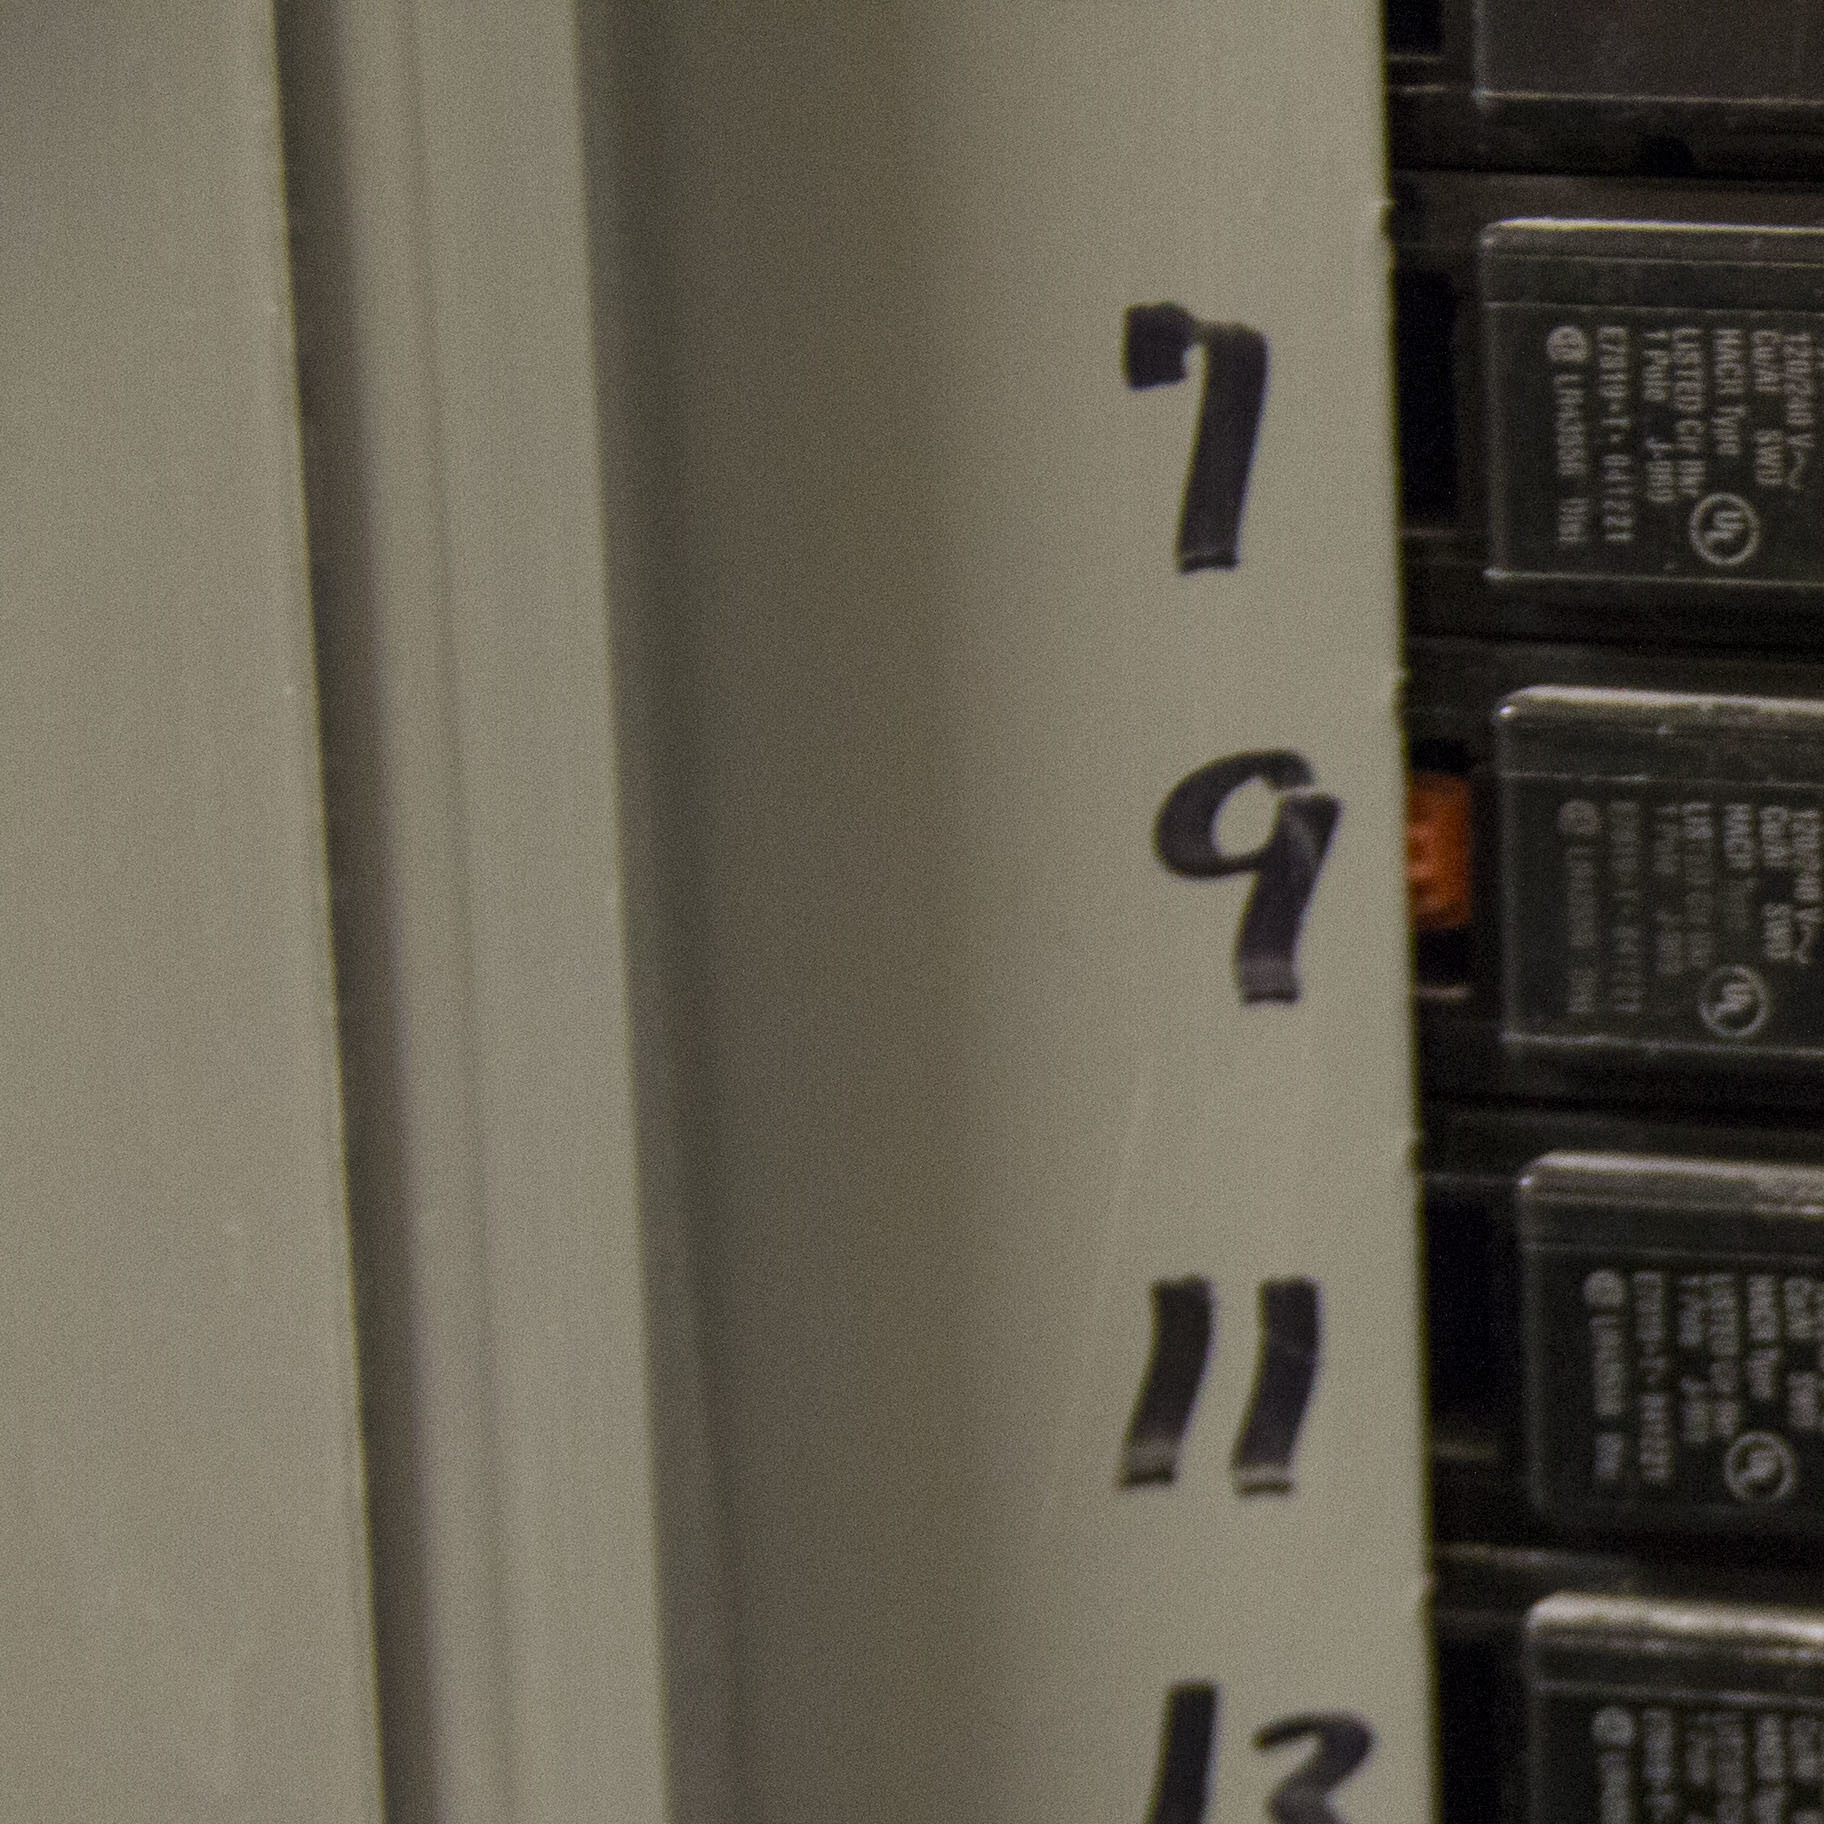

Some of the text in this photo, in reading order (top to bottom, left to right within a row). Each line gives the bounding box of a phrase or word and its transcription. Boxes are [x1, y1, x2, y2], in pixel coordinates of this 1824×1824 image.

[1123, 304, 1267, 572] 7
[1152, 748, 1342, 1005] 9
[1117, 1278, 1323, 1495] 11
